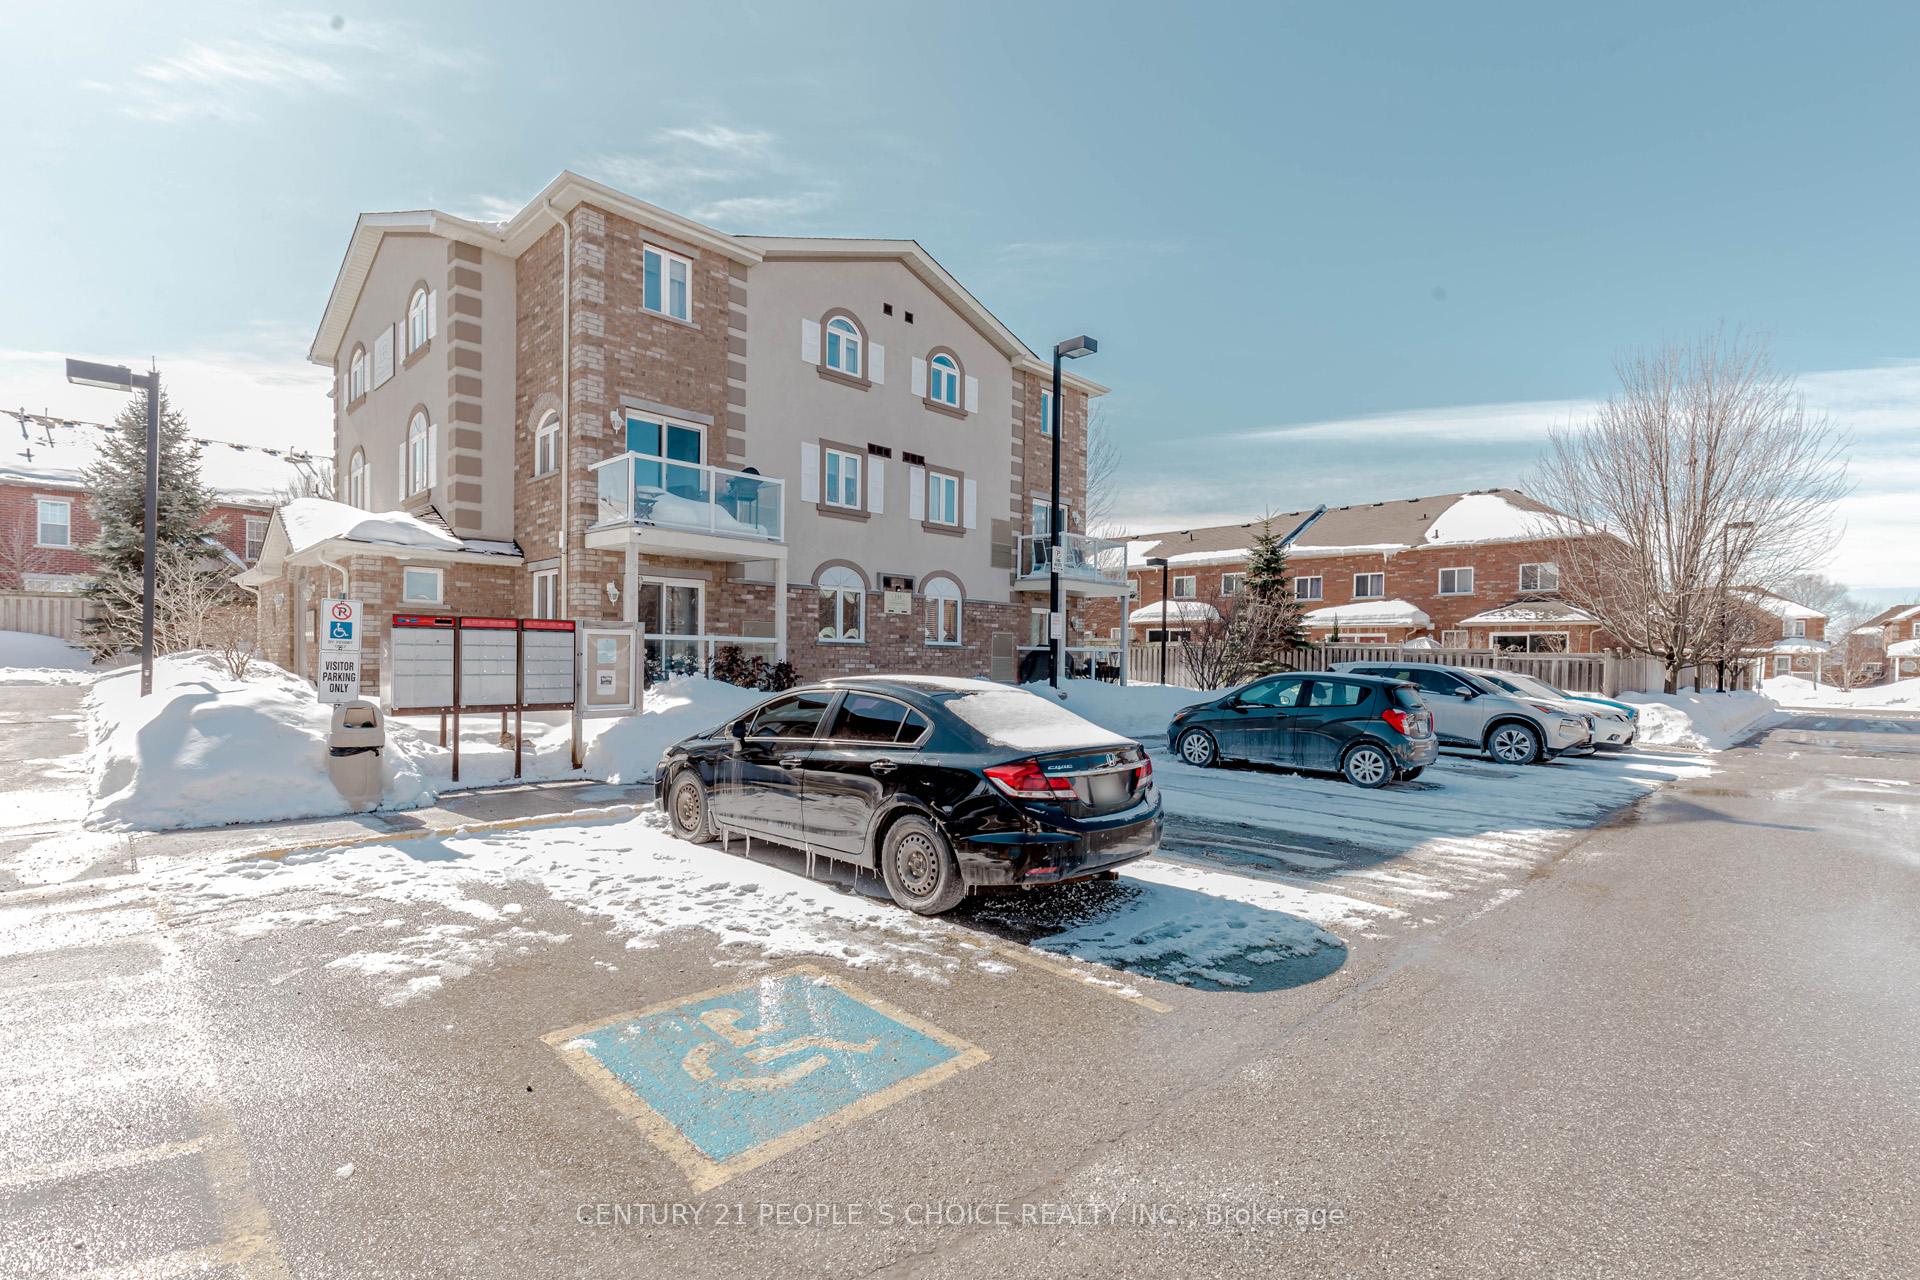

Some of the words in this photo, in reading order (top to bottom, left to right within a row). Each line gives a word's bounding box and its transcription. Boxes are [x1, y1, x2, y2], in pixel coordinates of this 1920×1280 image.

[325, 661, 354, 671] VISITOR
[322, 672, 356, 682] PARKING
[329, 684, 349, 693] ONLY
